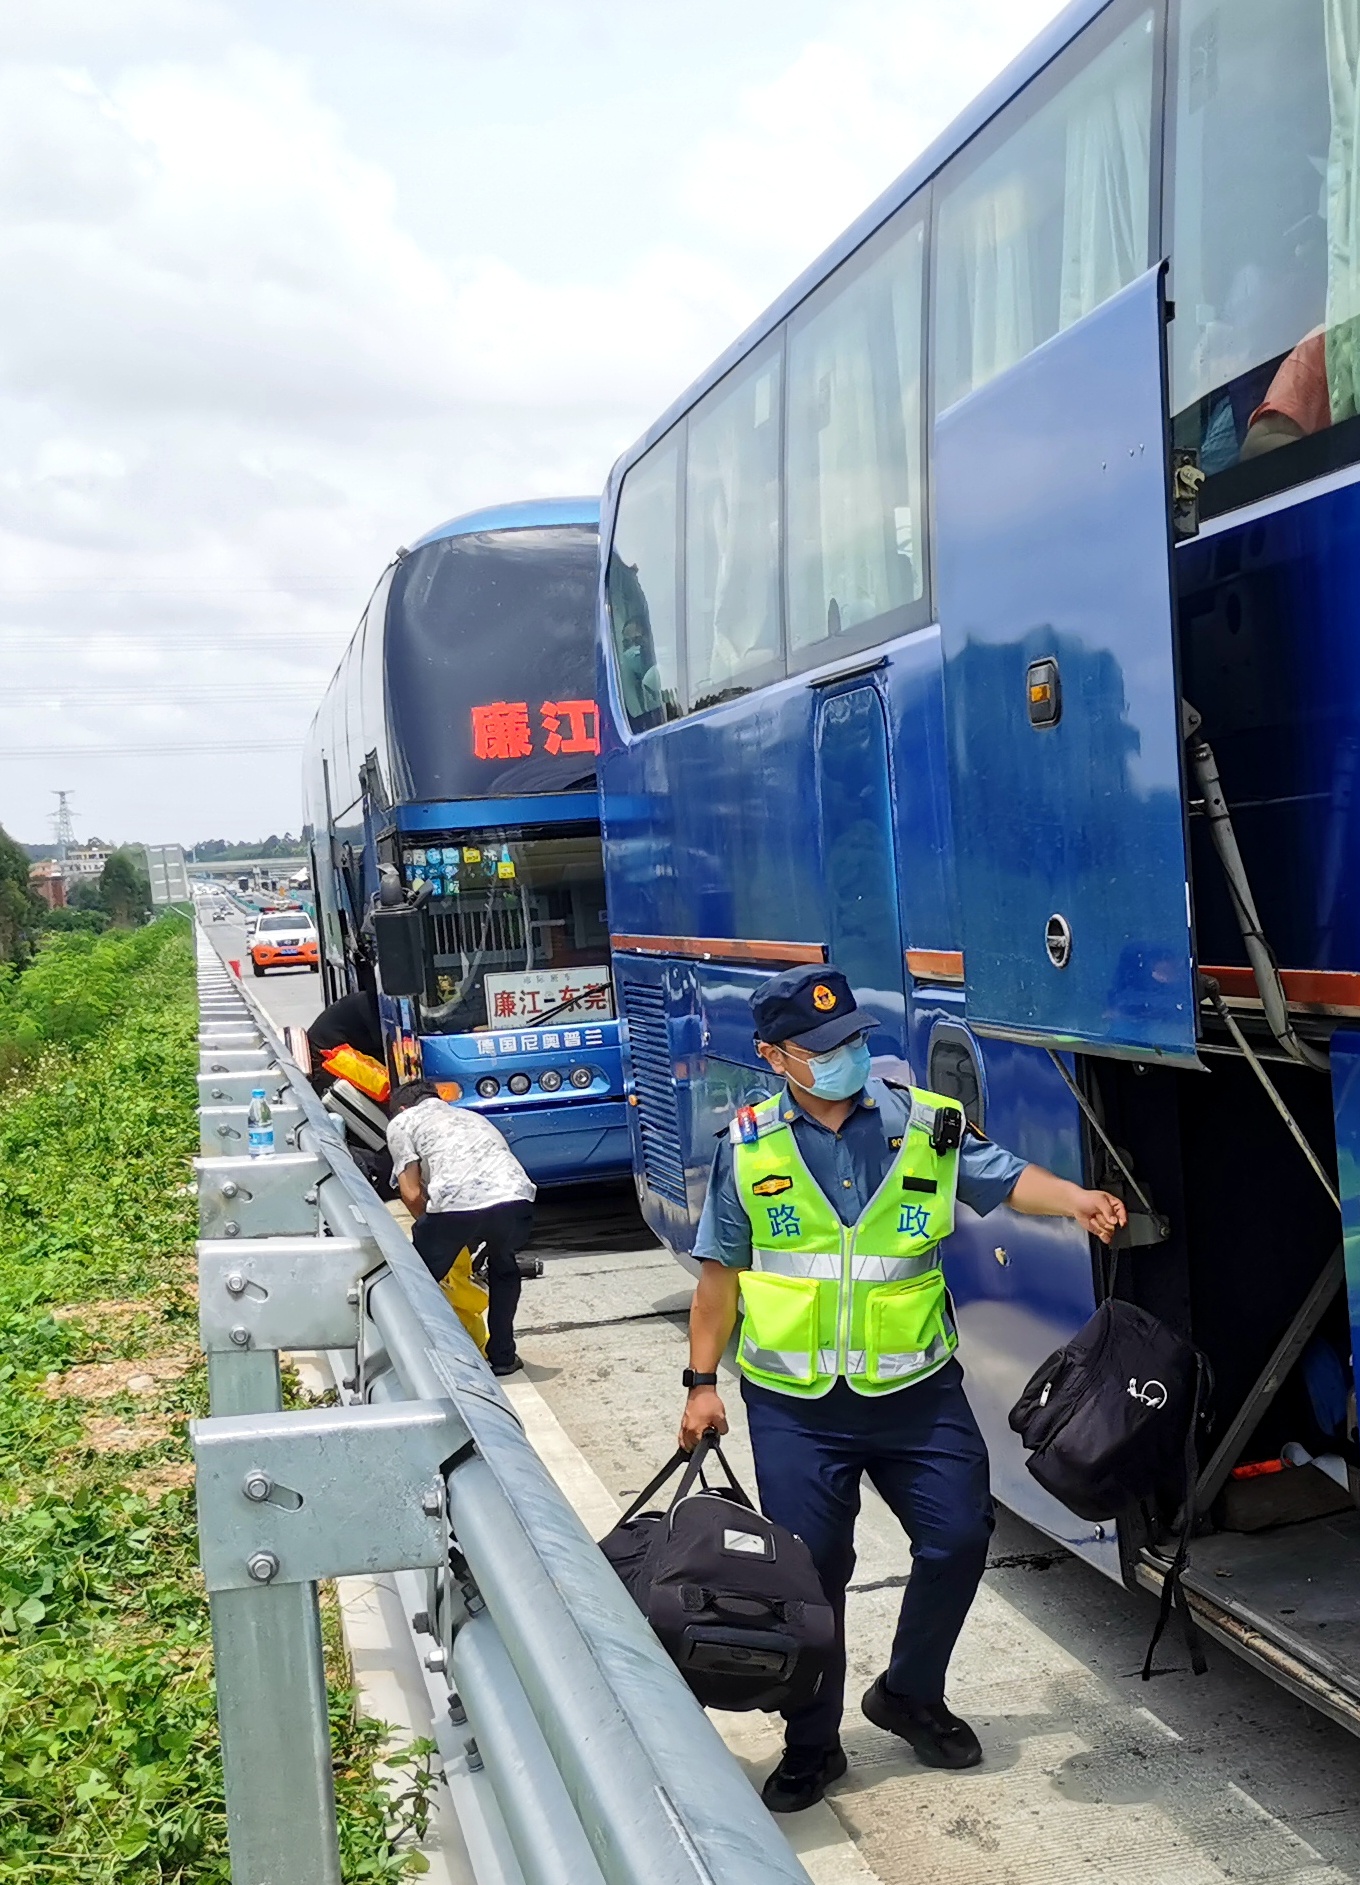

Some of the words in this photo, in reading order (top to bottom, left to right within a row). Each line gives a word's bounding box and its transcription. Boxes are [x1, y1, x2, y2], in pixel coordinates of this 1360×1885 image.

[471, 700, 600, 760] 廉江
[477, 1028, 604, 1055] 德国尼奥普兰
[767, 1204, 801, 1238] 路
[897, 1204, 931, 1239] 政
